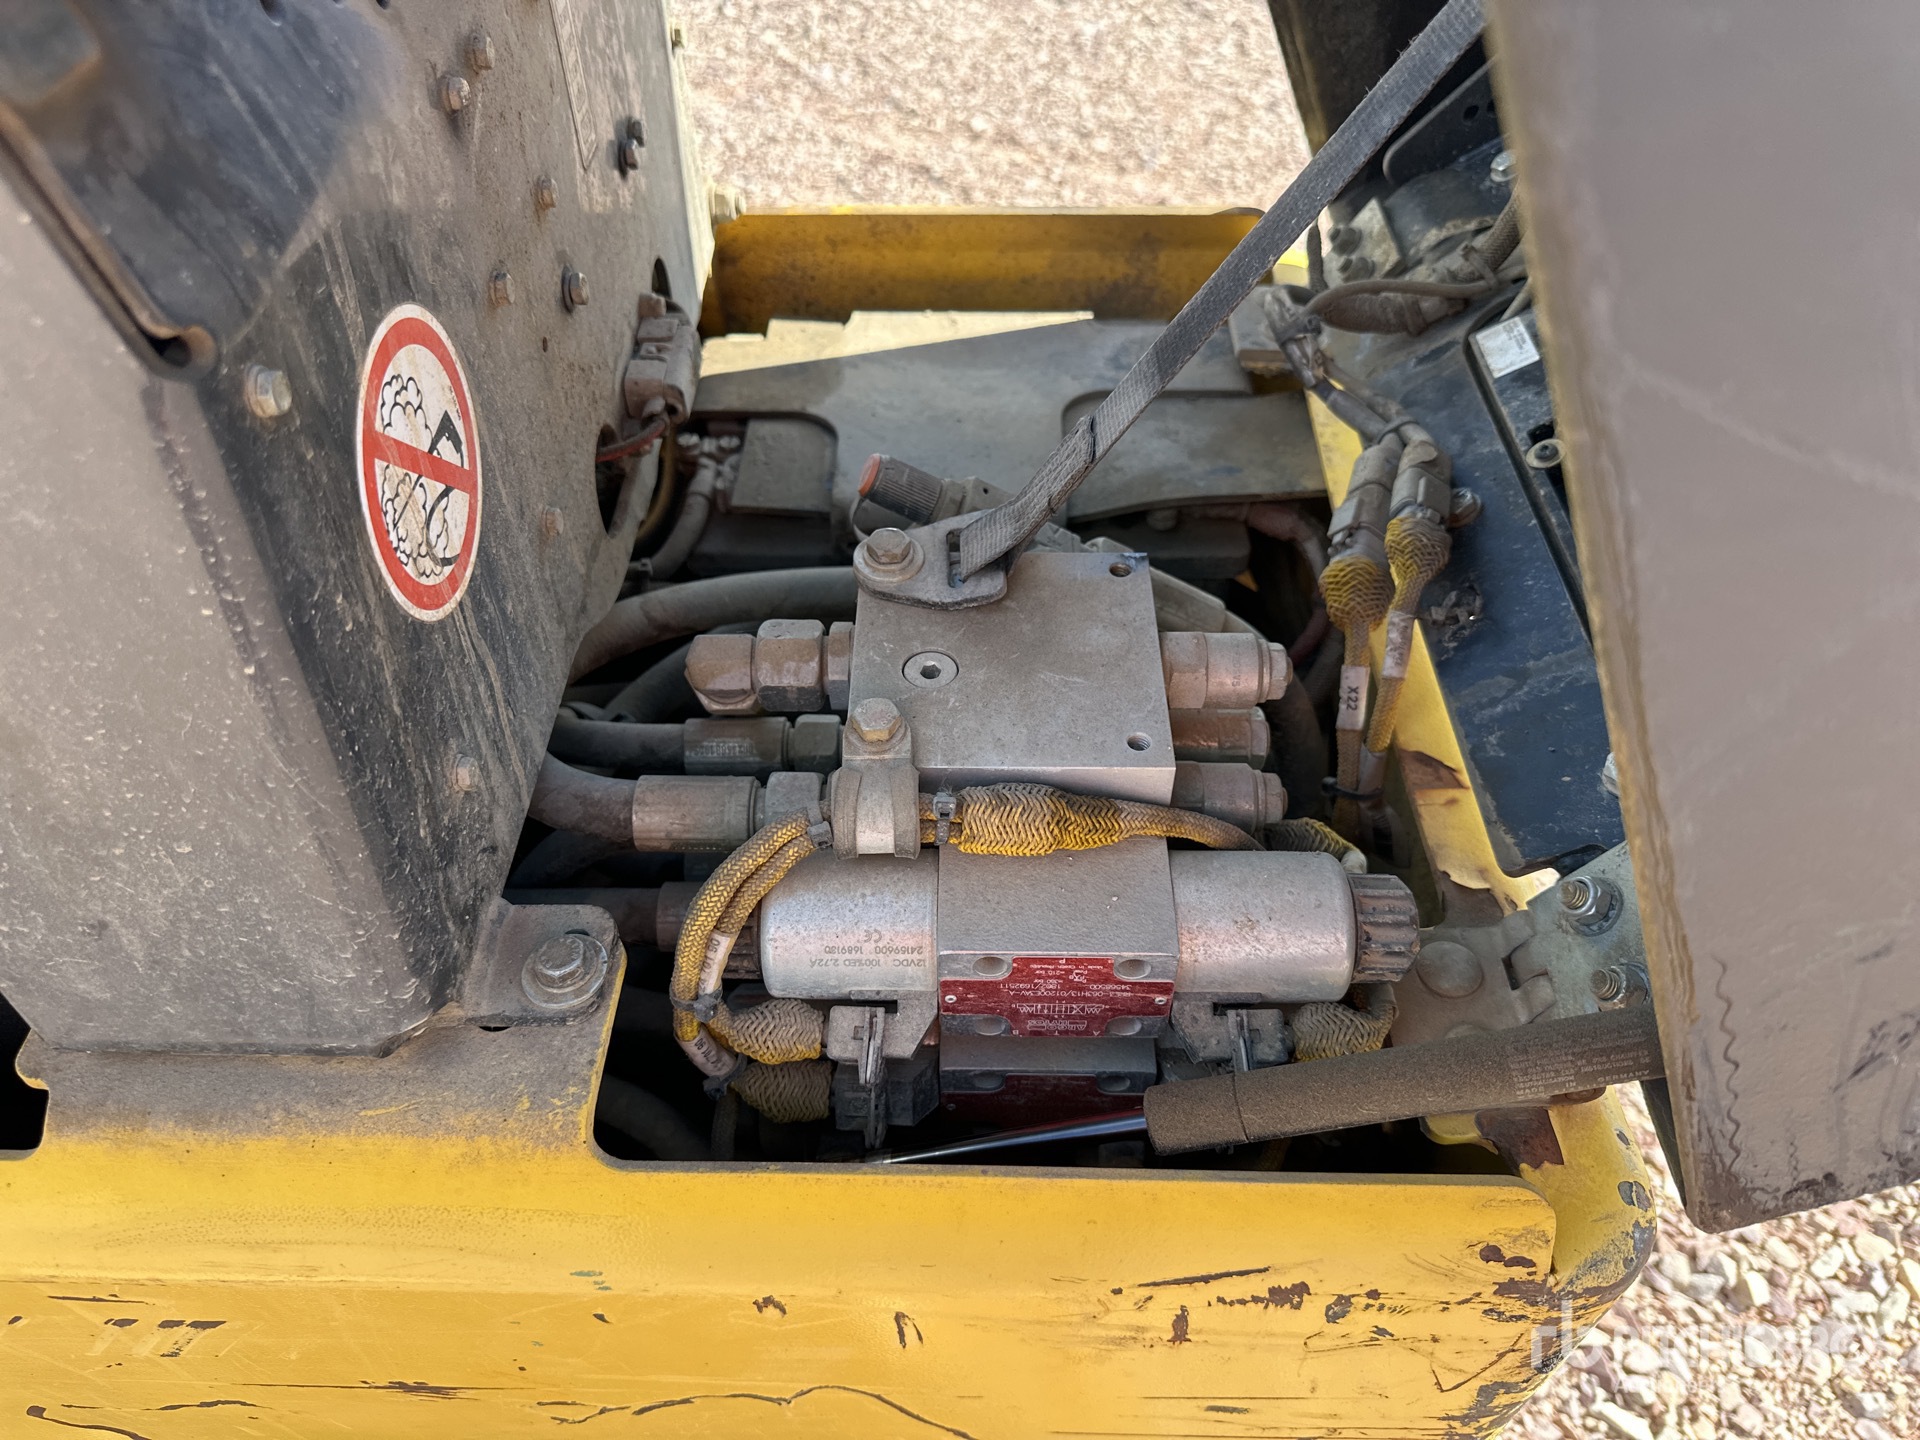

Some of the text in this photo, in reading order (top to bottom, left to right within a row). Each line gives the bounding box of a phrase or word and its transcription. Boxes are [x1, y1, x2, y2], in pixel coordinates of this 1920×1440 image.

[1346, 686, 1359, 711] X22
[874, 945, 923, 954] 24159600
[843, 958, 881, 967] 100%ED
[893, 958, 926, 967] 12VDC
[1516, 1087, 1545, 1095] MADE
[1597, 1070, 1650, 1082] GERMANY
